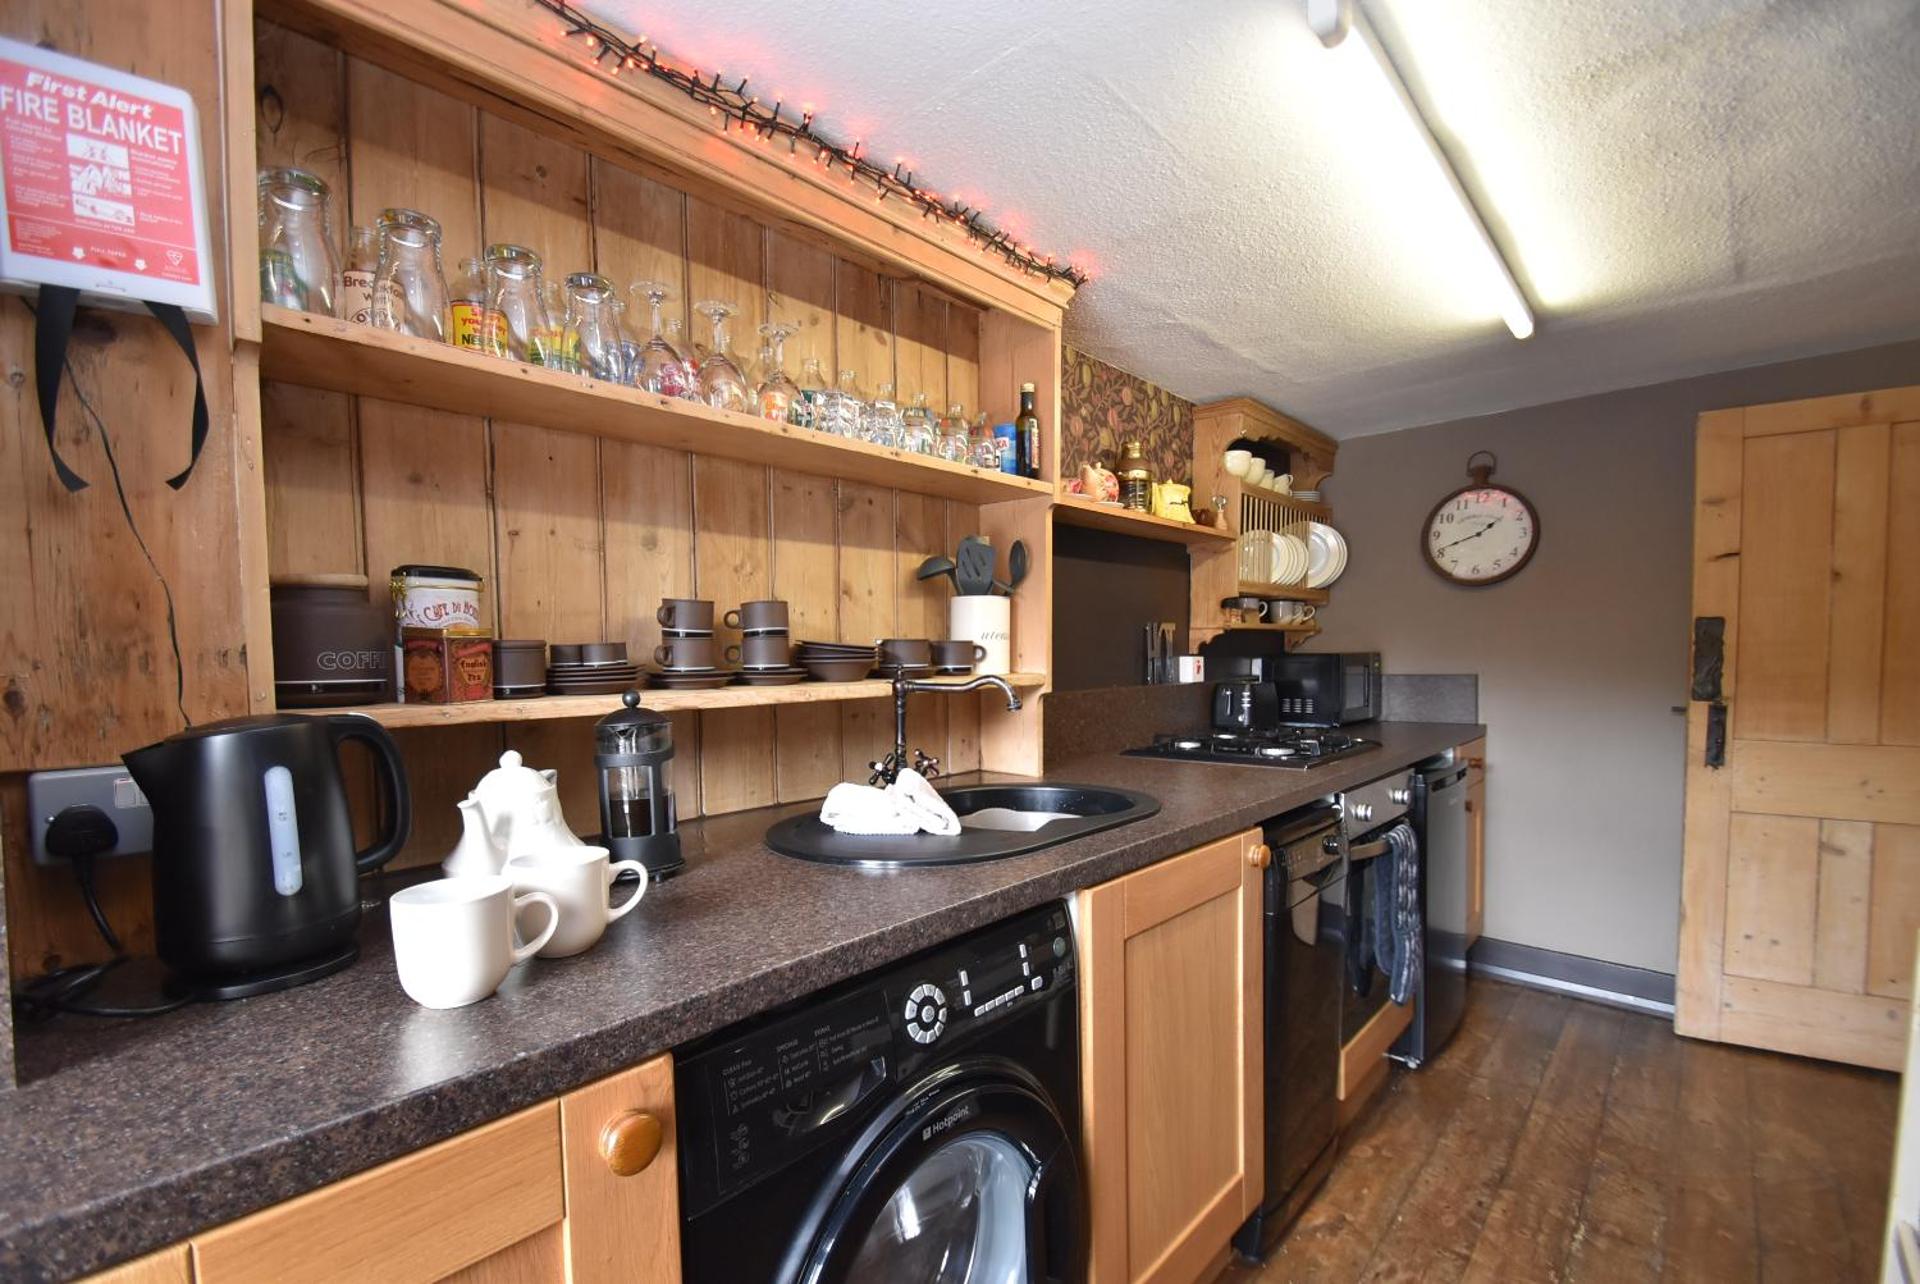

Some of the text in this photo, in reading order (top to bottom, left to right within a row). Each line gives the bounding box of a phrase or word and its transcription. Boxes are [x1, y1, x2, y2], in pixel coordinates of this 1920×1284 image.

[26, 71, 154, 120] First Alert
[0, 84, 61, 125] FIRE
[67, 102, 182, 155] BLANKET
[1475, 491, 1490, 504] 12
[1456, 499, 1469, 511] 11
[1439, 513, 1454, 524] 10
[1516, 511, 1524, 521] 2
[1433, 530, 1440, 541] 9
[1519, 526, 1528, 539] 3
[1436, 547, 1445, 559] 8
[1508, 547, 1518, 556] 4
[1450, 559, 1459, 570] 7
[1472, 565, 1480, 575] 6
[1493, 558, 1502, 571] 5
[931, 1105, 970, 1135] Hotpoint
